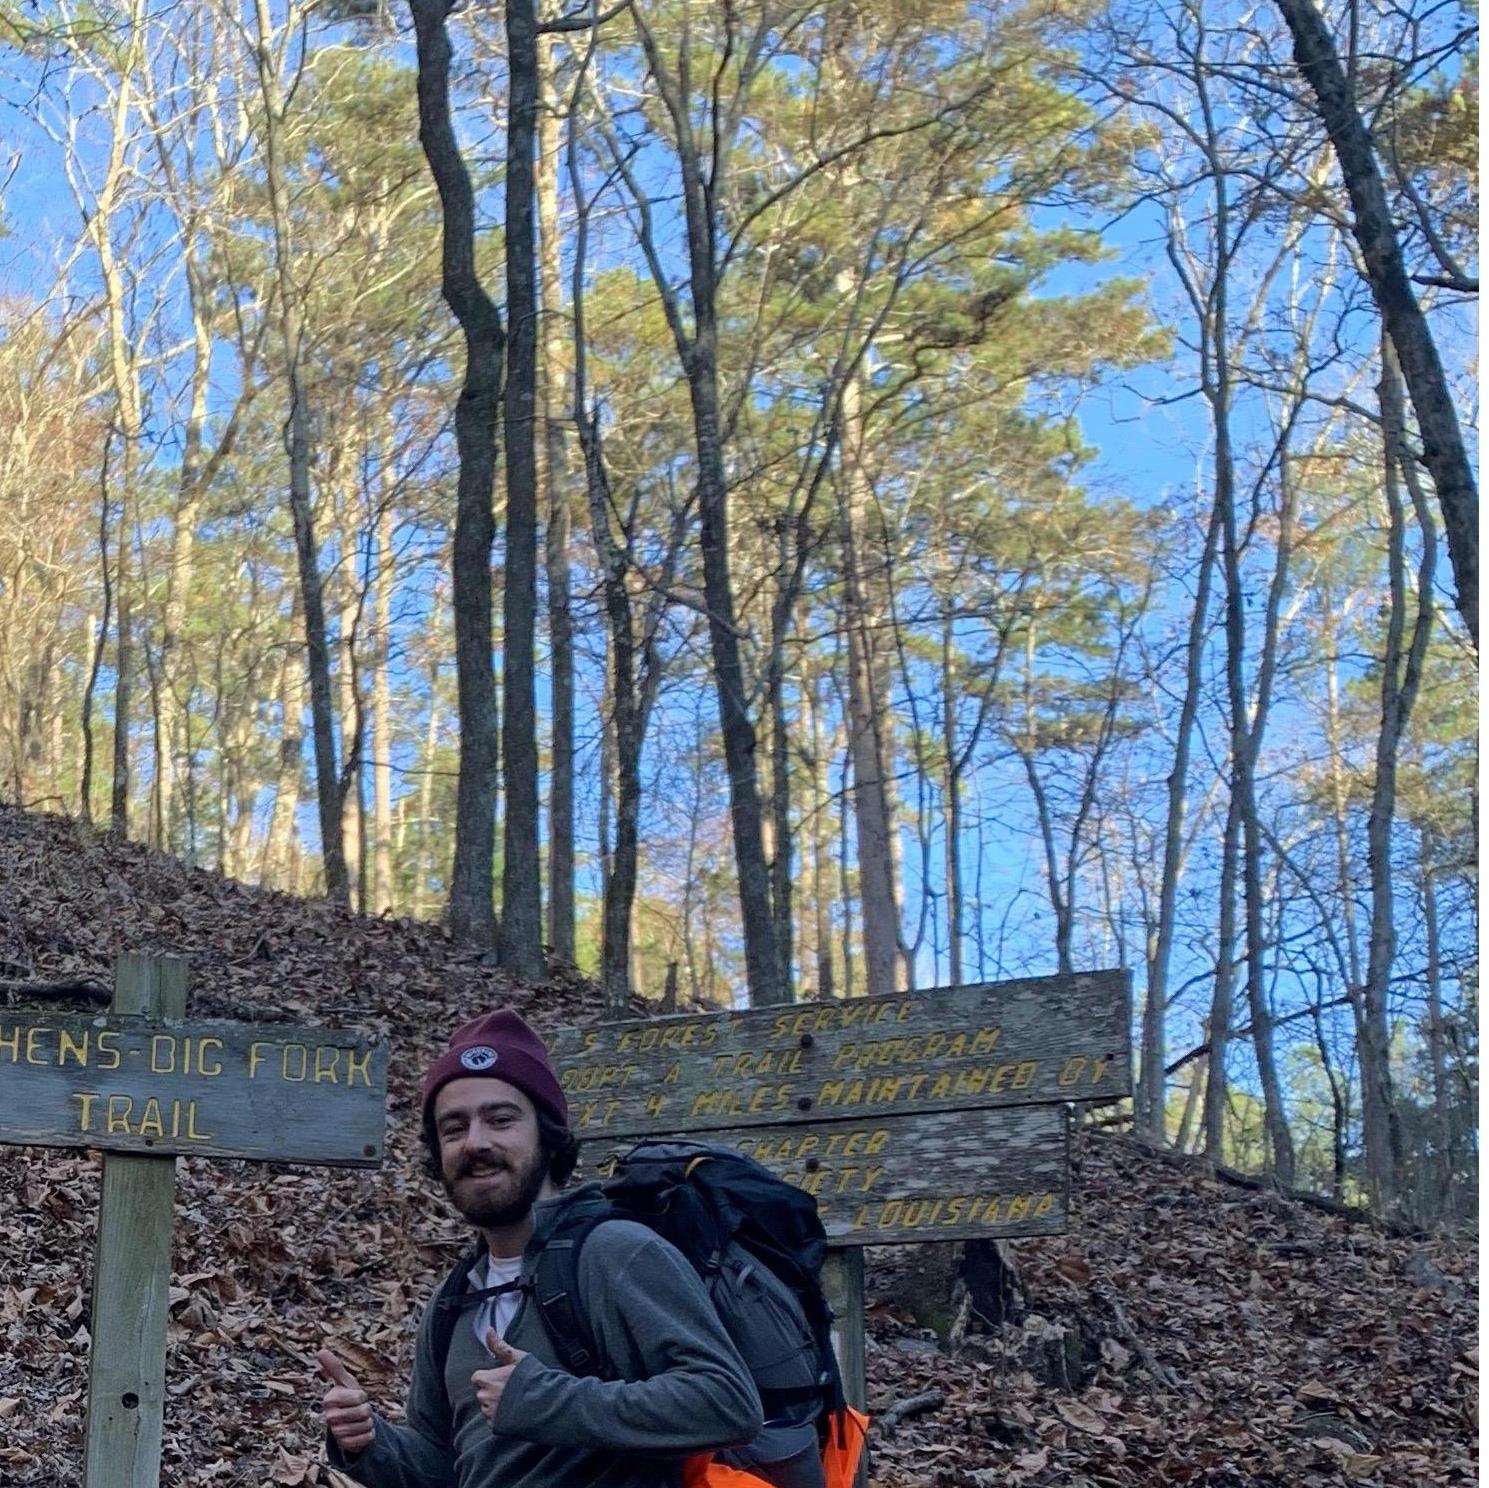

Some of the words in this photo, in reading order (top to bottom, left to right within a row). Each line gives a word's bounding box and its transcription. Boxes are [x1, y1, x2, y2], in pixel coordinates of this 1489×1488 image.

[616, 1018, 744, 1053] FOREST
[771, 1001, 912, 1038] SERVICE
[249, 1041, 373, 1087] FORK
[562, 1062, 641, 1091] DOPT
[663, 1061, 682, 1085] A
[714, 1050, 804, 1076] TRAIL
[833, 1026, 1002, 1072] PROGRAM
[644, 1093, 666, 1119] 4
[691, 1083, 796, 1117] MILES
[818, 1060, 1038, 1105] MAINTAINED
[1058, 1054, 1110, 1087] BY
[73, 1093, 212, 1140] TRAIL
[782, 1165, 885, 1196] CIETY
[854, 1190, 1055, 1231] LOUISIANA
